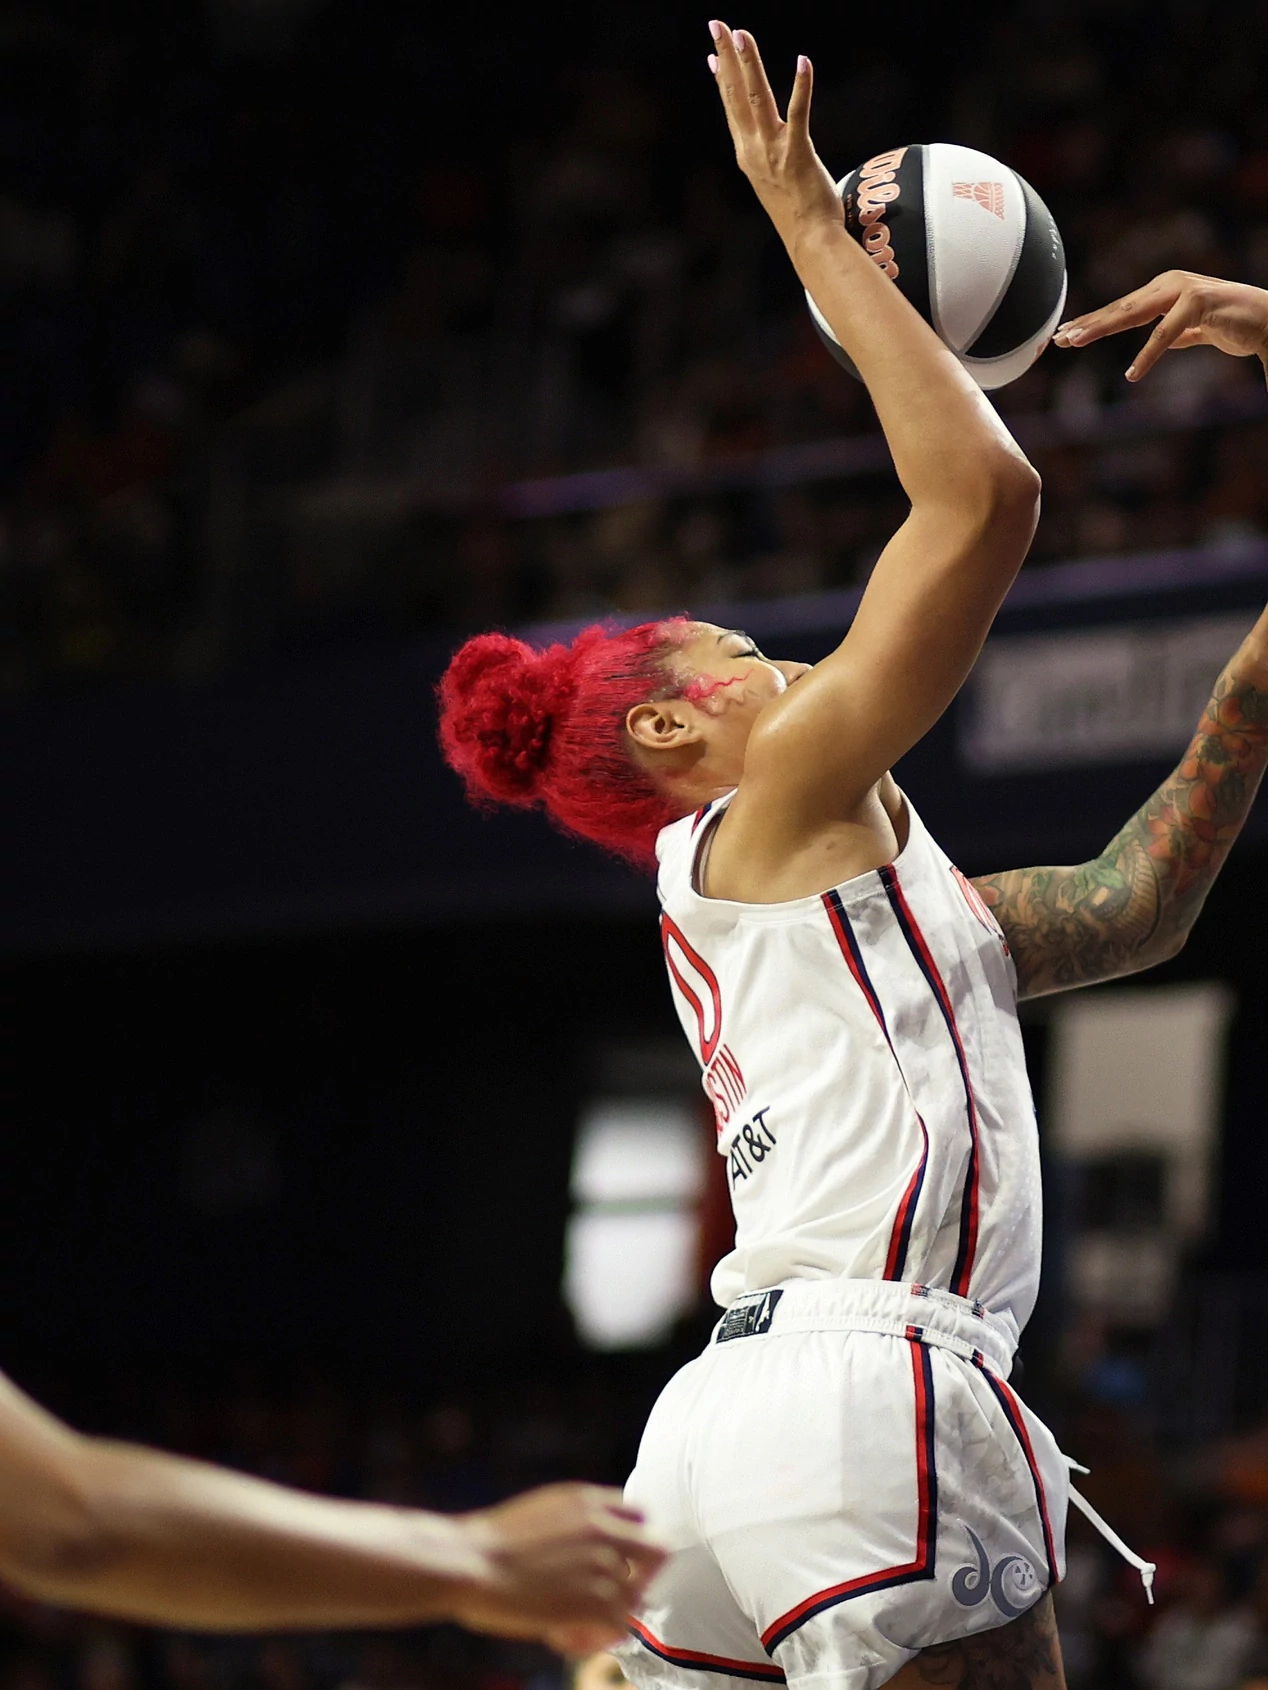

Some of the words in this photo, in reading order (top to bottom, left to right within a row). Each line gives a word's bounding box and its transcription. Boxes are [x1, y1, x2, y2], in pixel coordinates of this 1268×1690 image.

[857, 147, 909, 280] Wilson
[661, 908, 722, 1067] 0
[729, 1105, 777, 1191] AT&T
